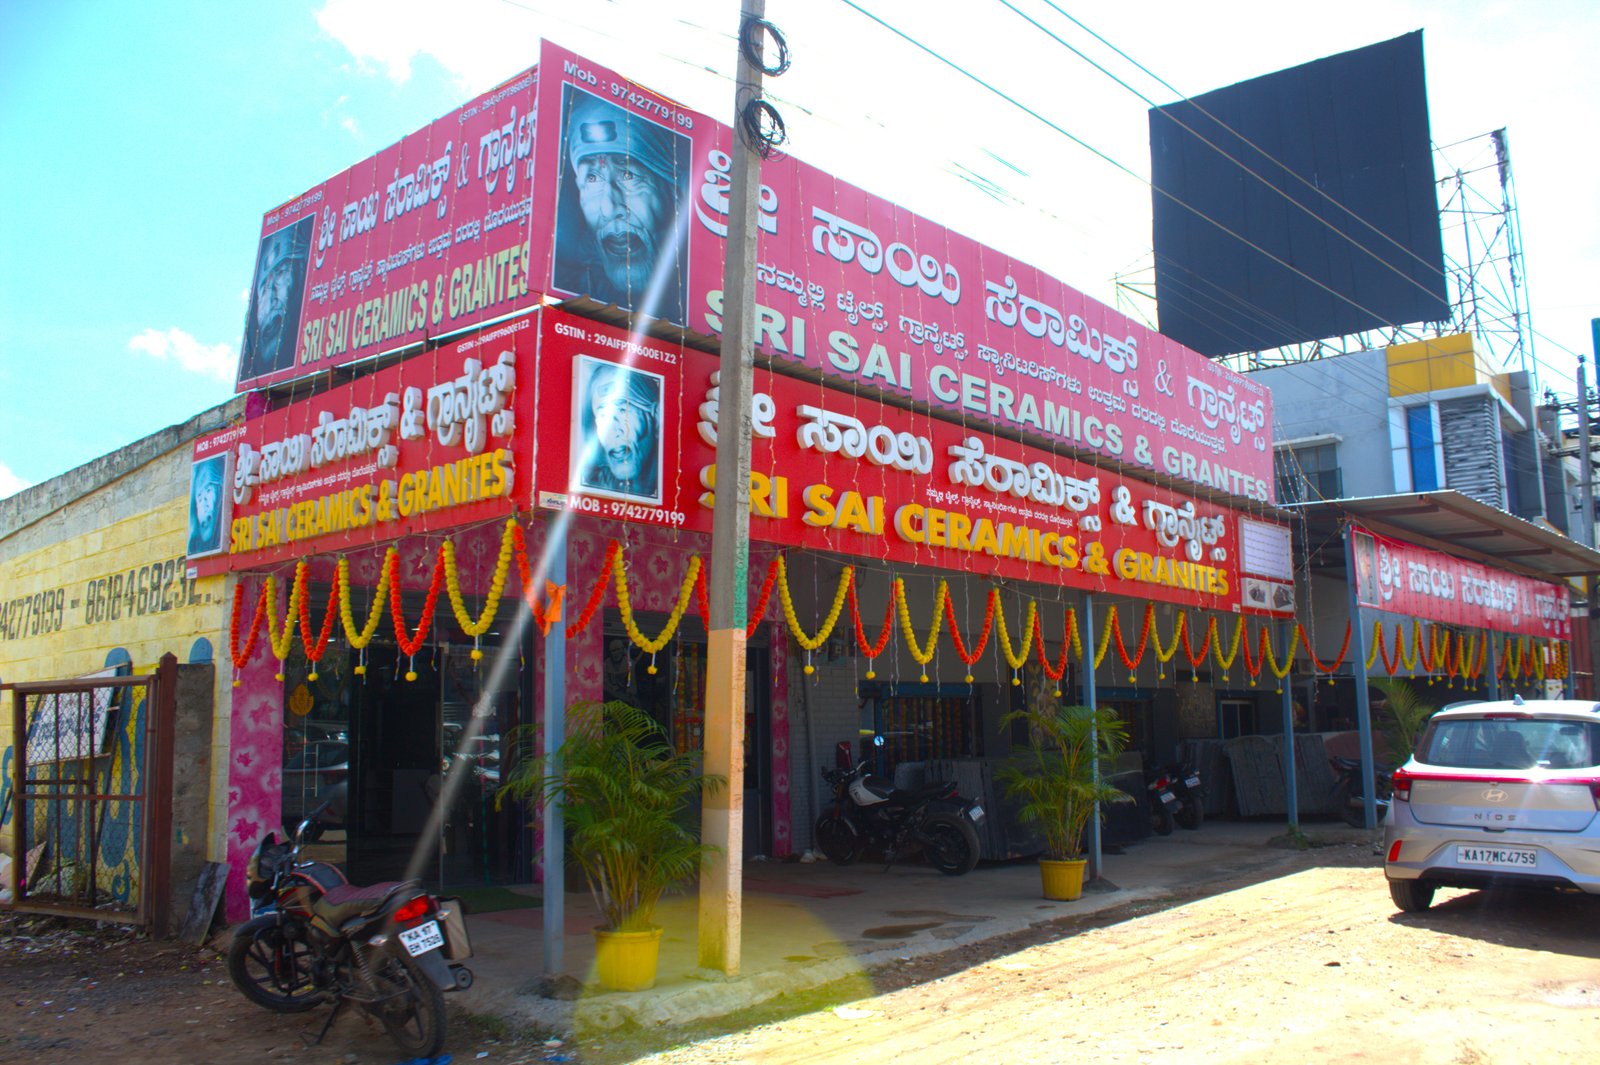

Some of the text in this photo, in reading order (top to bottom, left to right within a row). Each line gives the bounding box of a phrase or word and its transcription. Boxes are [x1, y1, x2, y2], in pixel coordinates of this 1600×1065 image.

[563, 60, 597, 87] Mob
[610, 82, 694, 130] 9742779199
[315, 204, 336, 269] ಶ್ರೀ
[339, 190, 379, 244] ಸಾಯಿ
[383, 140, 452, 220] ಸೆರಾಮಿಕ್ಸ್
[457, 142, 470, 189] &
[301, 241, 529, 365] SRI SAI CERAMICS & GRANTES
[554, 322, 586, 340] GSTIN
[594, 333, 677, 365] 29AIFPT9600E1Z2
[757, 262, 825, 312] ನಮ್ಮಲ್ಲಿ
[1088, 384, 1126, 413] ಉತ್ತಮ
[1131, 402, 1167, 434] ದರದಲ್ಲಿ
[812, 206, 961, 305] ಸಾಯಿ
[985, 275, 1139, 398] ಸೆರಾಮಿಕ್ಸ್
[1155, 359, 1174, 397] &
[1187, 372, 1265, 452] ಗ್ರಾನೈಟ್ಸ್
[213, 426, 247, 447] 974277999
[233, 442, 259, 504] ಶ್ರೀ
[259, 433, 309, 483] ಸಾಯಿ
[311, 393, 397, 469] ಸೆರಾಮಿಕ್ಸ್
[400, 387, 424, 440] &
[427, 350, 515, 452] ಗ್ರಾನೈಟ್ಸ್
[827, 331, 912, 390] SAI
[929, 365, 1123, 455] CERAMICS
[1133, 435, 1153, 466] &
[1163, 446, 1268, 502] GRANTES
[231, 517, 256, 554] SRI
[256, 509, 286, 548] SAI
[285, 484, 375, 540] CERAMICS
[376, 480, 396, 522] &
[399, 448, 513, 517] GRANITES
[570, 495, 600, 512] MOB
[611, 502, 685, 525] 9742779199
[798, 404, 934, 475] ಸಾಯಿ
[948, 436, 1101, 532] ಸೆರಾಮಿಕ್ಸ್
[1110, 484, 1137, 527] &
[1142, 500, 1227, 562] ಗ್ರಾನೈಟ್ಸ್
[802, 483, 886, 536] SAI
[894, 500, 1079, 569] CERAMICS
[1083, 541, 1110, 576] &
[1112, 547, 1229, 596] GRANITES
[0, 588, 64, 640] 42779199
[1464, 849, 1536, 865] KA17MC4759
[1474, 811, 1516, 822] NIOS
[407, 930, 421, 941] KA
